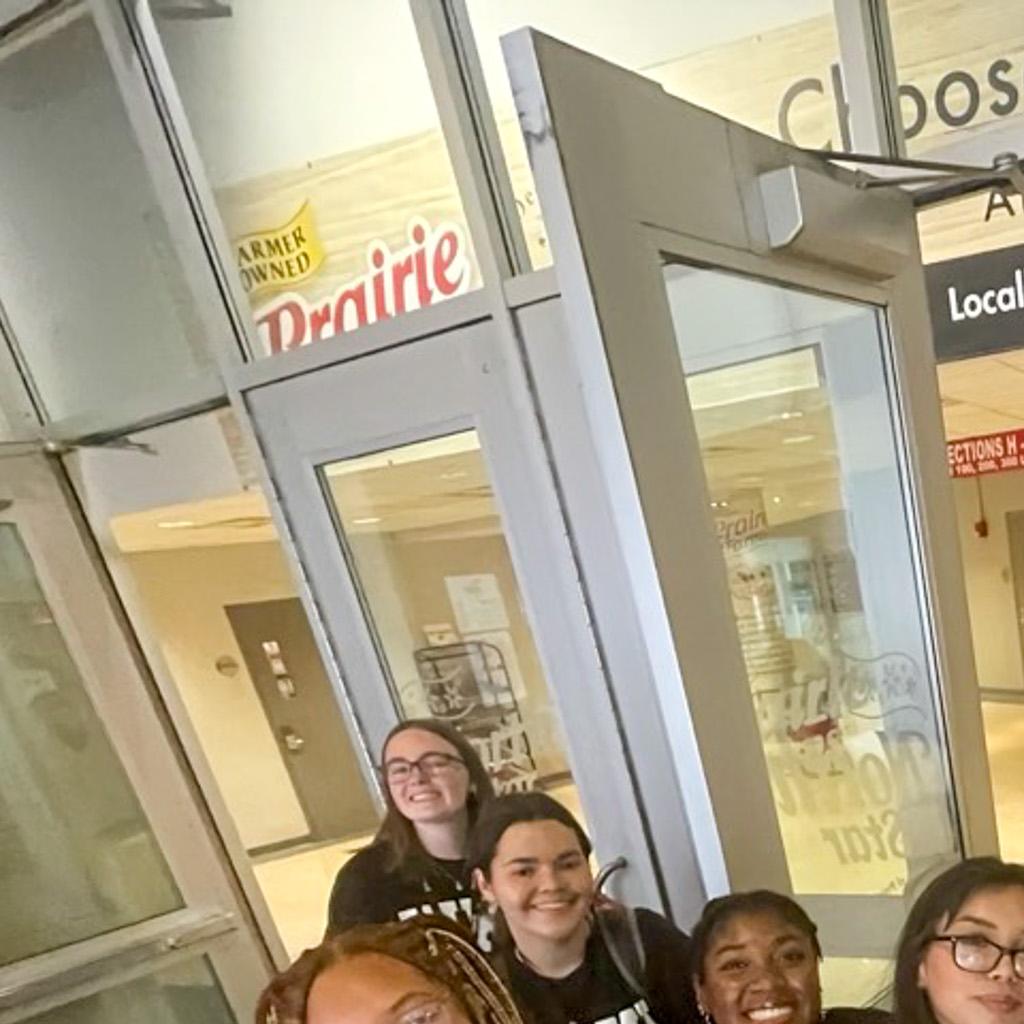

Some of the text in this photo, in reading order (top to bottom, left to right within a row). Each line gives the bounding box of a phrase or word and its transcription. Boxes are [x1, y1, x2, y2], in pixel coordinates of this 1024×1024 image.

[239, 251, 310, 293] OWNED
[256, 223, 464, 356] Prairie
[1006, 433, 1018, 456] H
